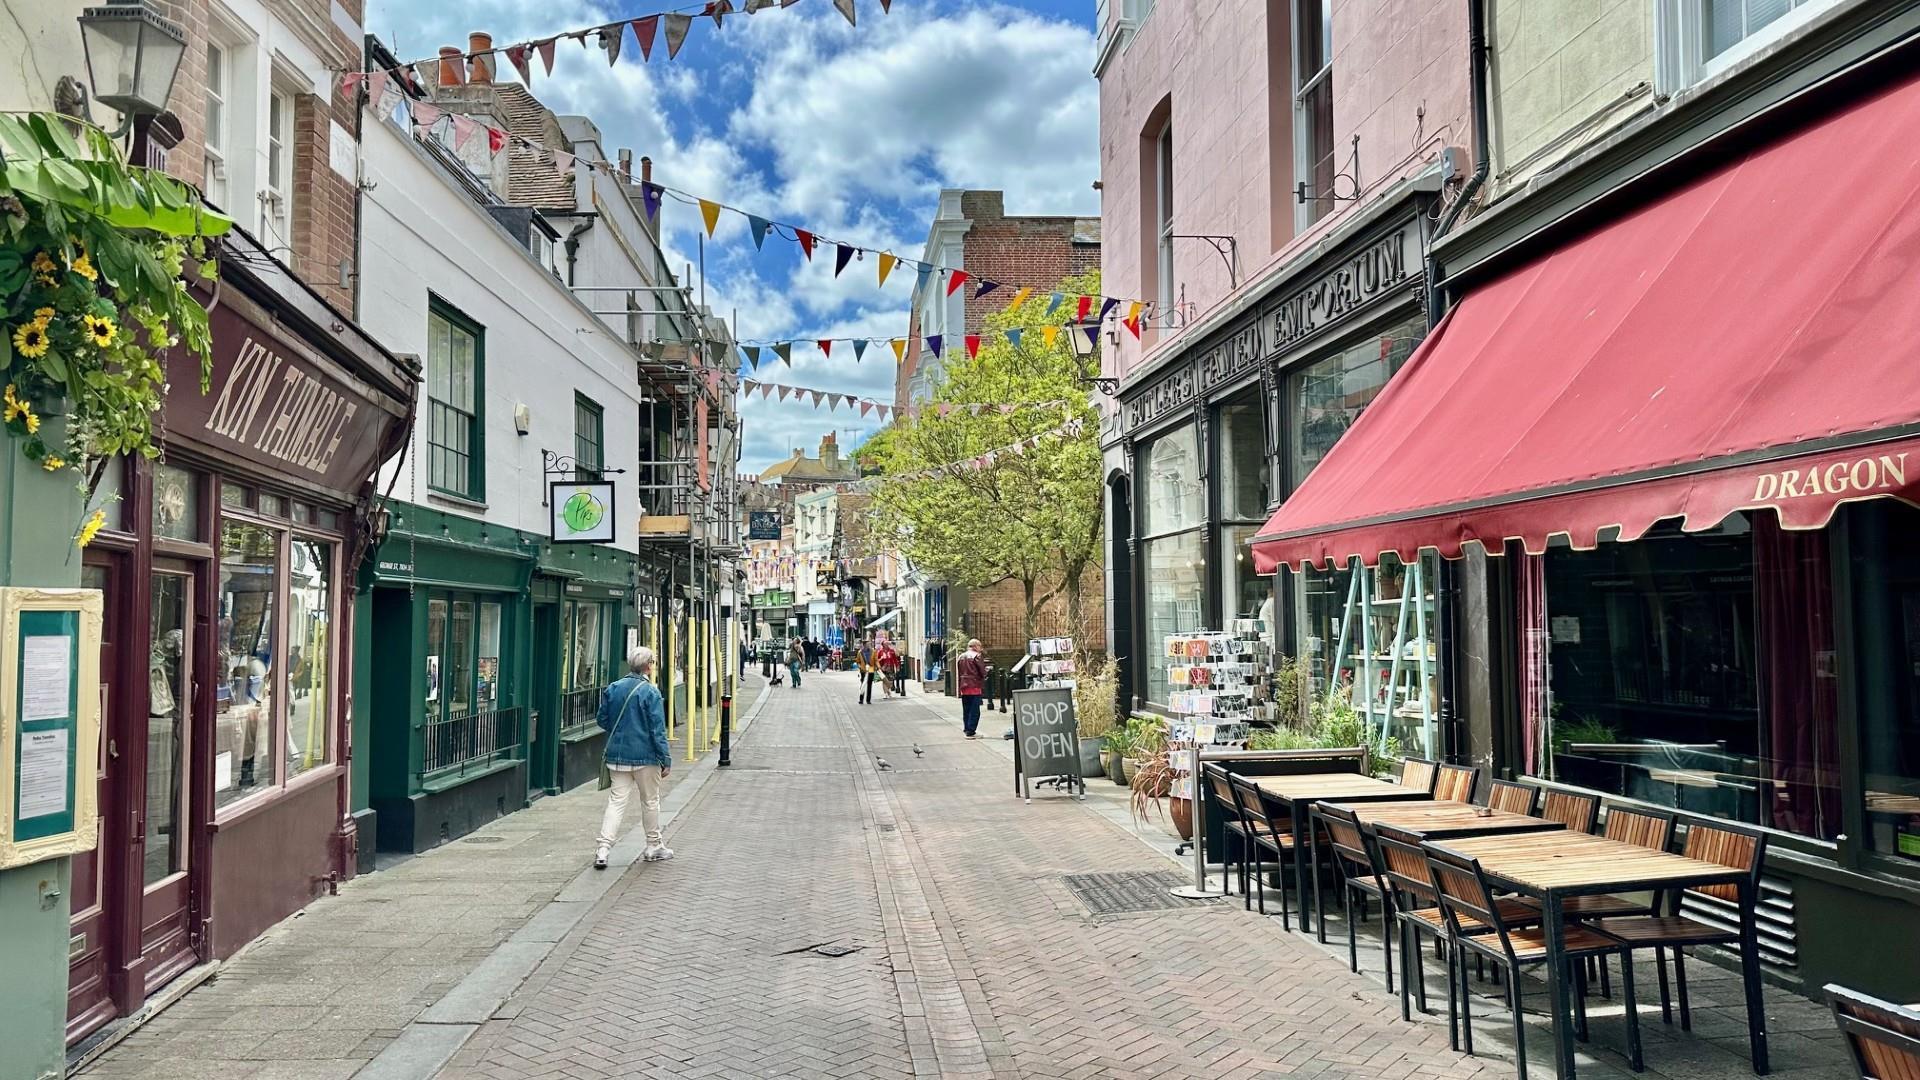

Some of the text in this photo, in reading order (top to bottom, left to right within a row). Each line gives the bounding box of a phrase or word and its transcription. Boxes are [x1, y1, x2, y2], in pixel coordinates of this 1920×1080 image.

[1130, 367, 1192, 428] BUTLERS
[1273, 230, 1406, 349] EMPORIUM
[205, 337, 357, 474] KIN THIMBLE
[1751, 453, 1909, 502] DRAGON
[1021, 701, 1069, 726] SHOP
[1025, 732, 1074, 759] OPEN
